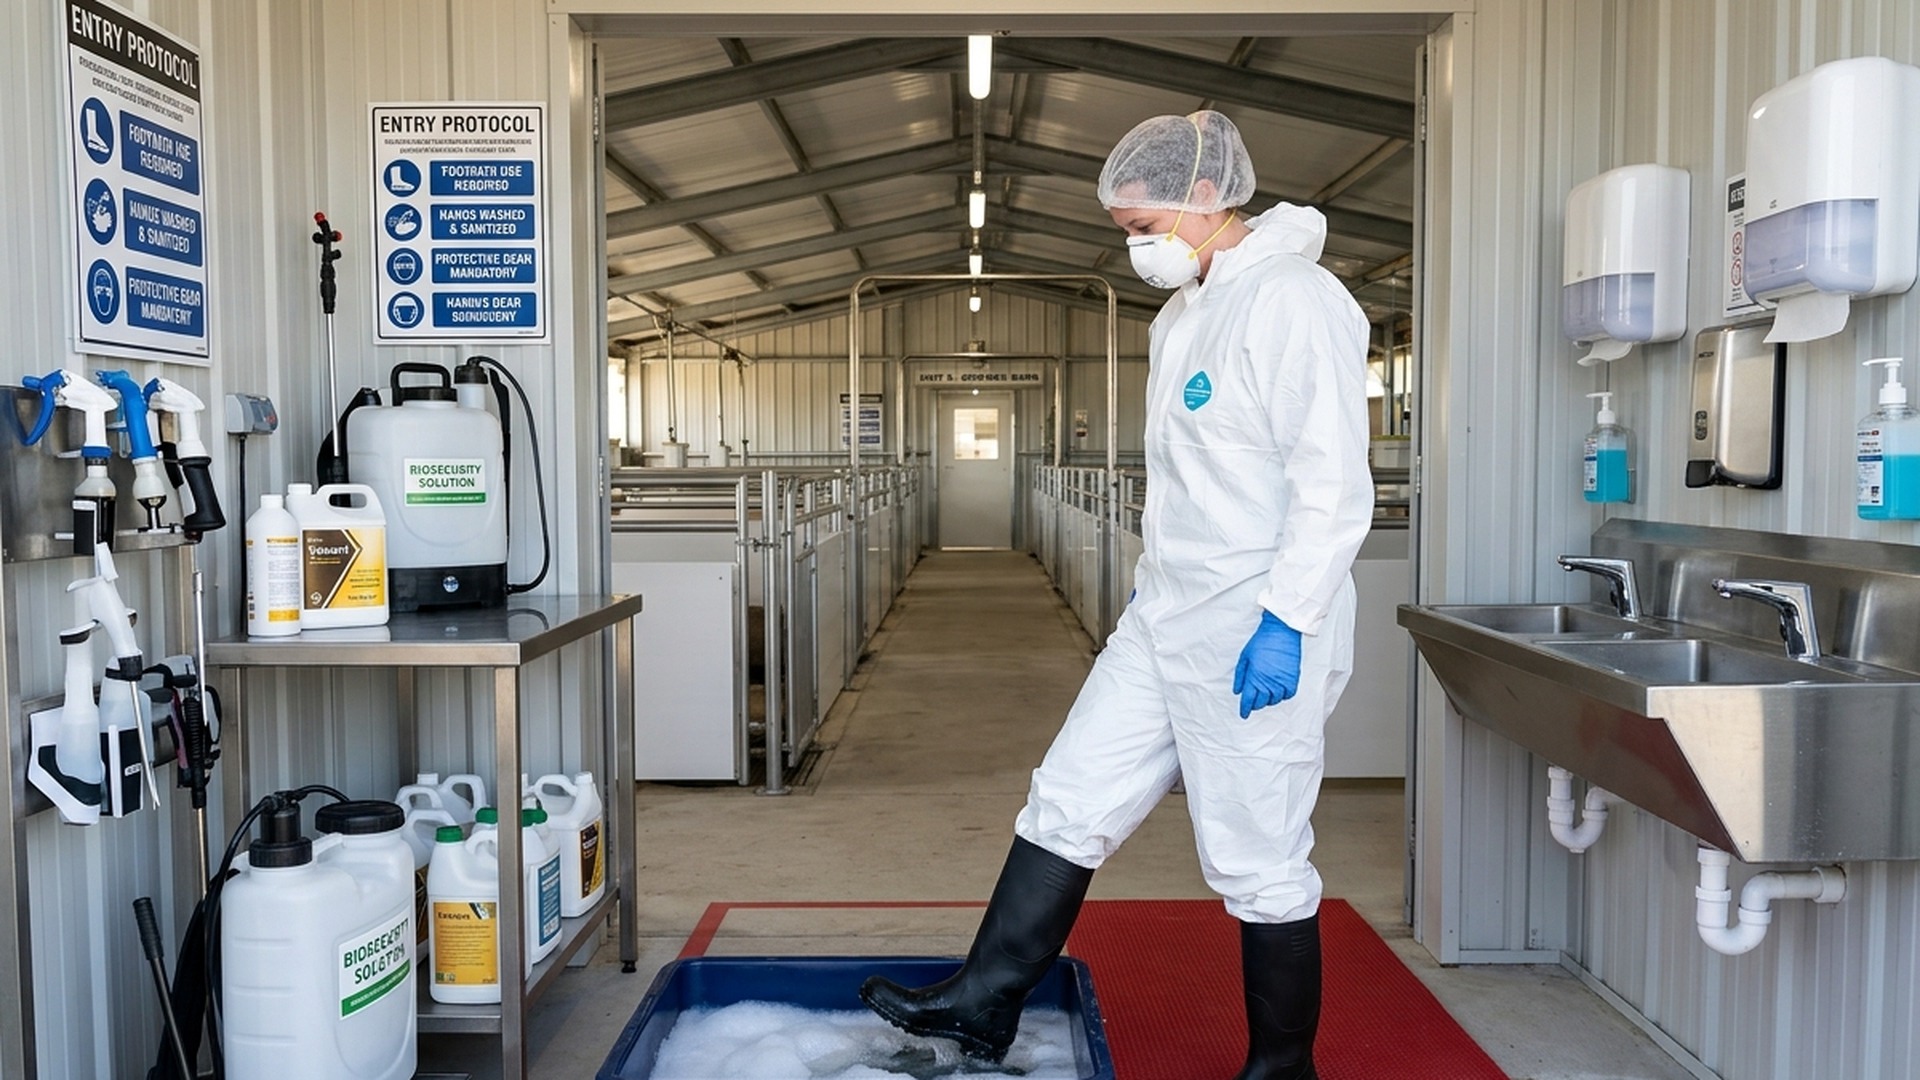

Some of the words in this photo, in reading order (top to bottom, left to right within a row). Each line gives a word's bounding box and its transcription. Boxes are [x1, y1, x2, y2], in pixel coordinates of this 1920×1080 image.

[71, 4, 123, 52] ENTRY
[127, 31, 197, 89] PROTOCOL
[380, 116, 436, 133] ENTRY
[442, 116, 535, 133] PROTOCOL
[500, 166, 522, 177] USE
[418, 478, 475, 488] SOLUTION
